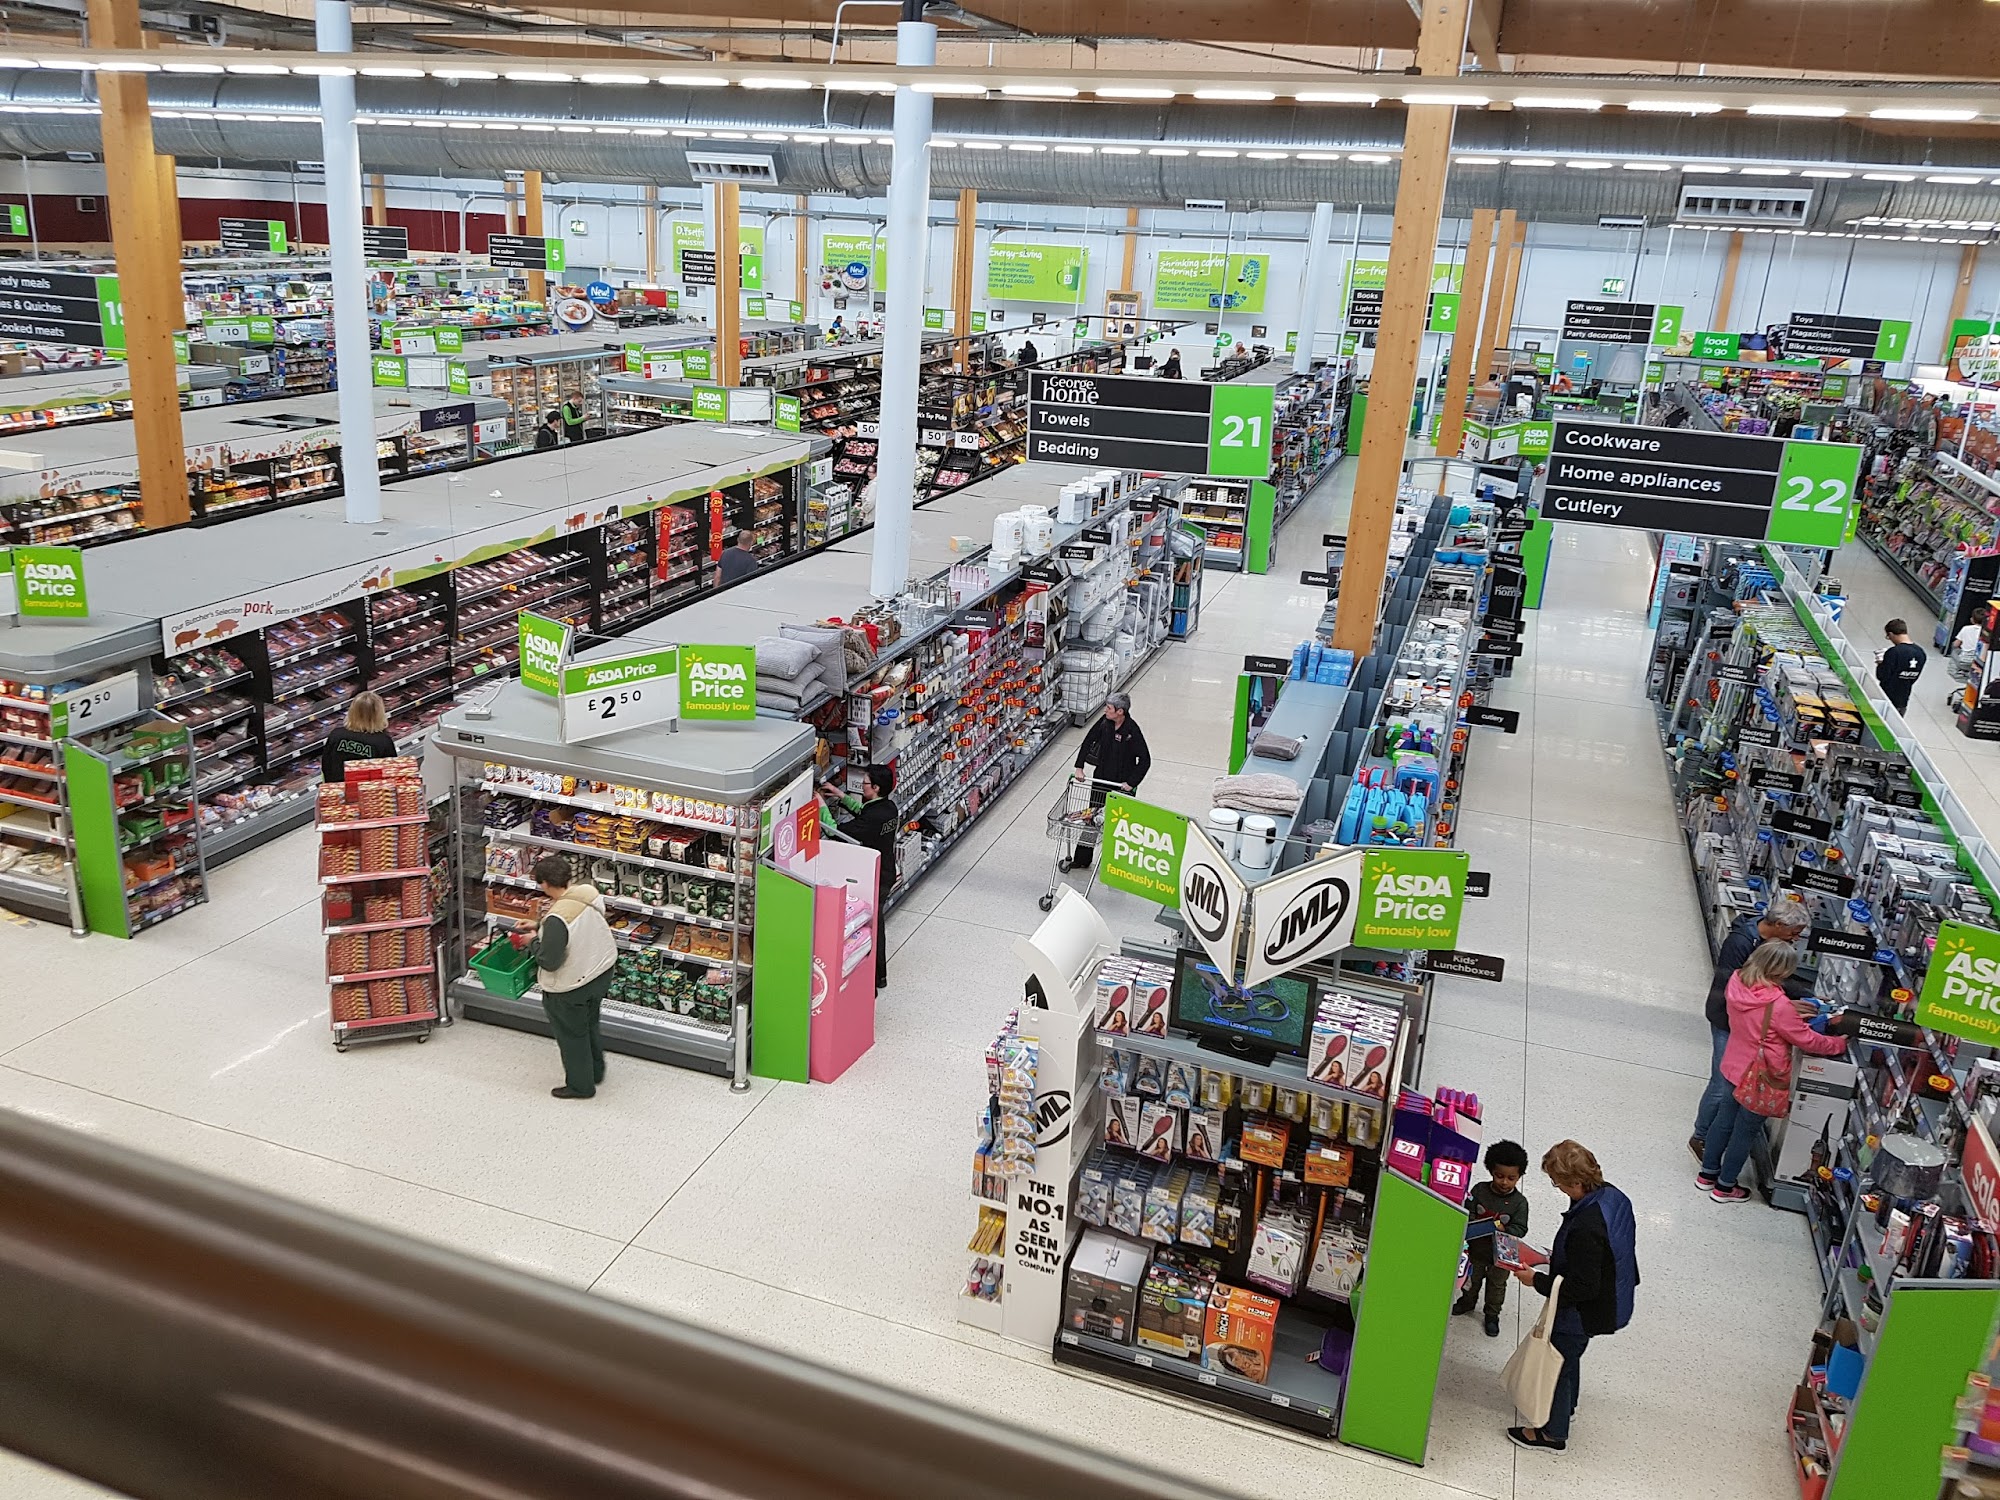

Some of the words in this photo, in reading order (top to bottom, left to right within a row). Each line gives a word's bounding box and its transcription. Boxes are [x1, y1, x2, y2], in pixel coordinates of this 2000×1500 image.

[274, 232, 280, 242] 7
[506, 238, 523, 246] baking
[827, 238, 853, 252] Energy
[552, 250, 560, 261] 5
[1160, 258, 1199, 270] Shrinking
[1201, 256, 1228, 267] carbo
[748, 267, 757, 278] 4
[1159, 267, 1198, 277] footprints
[591, 282, 610, 296] New!
[1355, 305, 1373, 313] Light
[1440, 306, 1452, 320] 3
[1570, 304, 1584, 312] Gift
[1569, 317, 1590, 325] Cards
[1660, 319, 1673, 333] 2
[1795, 315, 1813, 324] Toys
[35, 326, 65, 337] meats
[221, 328, 239, 336] £10
[1566, 330, 1586, 339] Party
[1588, 332, 1631, 340] decorations
[1791, 328, 1832, 339] Magazines
[1704, 337, 1729, 346] food
[1888, 334, 1897, 348] 1
[1714, 348, 1727, 357] go
[1788, 342, 1805, 351] Bike
[1807, 344, 1850, 355] accessories
[378, 360, 401, 369] ASDA
[686, 356, 706, 364] ASDA
[451, 368, 466, 376] ASDA
[658, 363, 667, 372] £2
[452, 376, 465, 384] Price
[697, 392, 721, 402] ASDA
[1042, 380, 1099, 404] home
[698, 401, 720, 411] Price
[779, 403, 797, 413] ASDA
[780, 411, 796, 421] Price
[1039, 410, 1090, 427] Towels
[1220, 416, 1262, 448] 21
[1469, 437, 1479, 449] £40
[1523, 438, 1547, 446] Price
[1565, 431, 1660, 452] Cookware
[1038, 440, 1099, 460] Bedding
[1560, 464, 1614, 482] Home
[1620, 472, 1722, 493] appliances
[1781, 476, 1847, 514] 22
[1554, 497, 1622, 518] Cutlery
[24, 564, 76, 580] ASDA
[1030, 569, 1048, 578] Candles
[1308, 575, 1329, 583] Bedding
[27, 581, 76, 597] Price
[24, 599, 64, 608] famously
[66, 600, 83, 608] low
[171, 623, 183, 633] Our
[185, 612, 214, 628] Butcher's
[215, 606, 242, 618] Selection
[243, 601, 273, 616] pork
[274, 608, 290, 616] joints
[301, 602, 314, 612] hand
[315, 595, 332, 607] scored
[340, 580, 359, 595] perfect
[358, 564, 379, 582] crackling
[965, 614, 987, 622] Candles
[1494, 618, 1516, 626] Kitchen
[525, 633, 558, 657] ASDA
[1488, 643, 1511, 652] Cutlery
[526, 654, 558, 674] Price
[689, 662, 747, 680] ASDA
[587, 668, 623, 686] ASDA
[625, 663, 657, 678] Price
[1722, 672, 1747, 680] Toasters
[692, 681, 744, 698] Price
[686, 702, 730, 712] famously
[732, 702, 750, 711] low
[1481, 713, 1504, 723] cutlery
[1739, 734, 1770, 744] Hardware
[1740, 729, 1771, 738] Electrical
[337, 740, 372, 757] ASDA
[1758, 778, 1793, 789] appliances
[1765, 772, 1788, 781] kitchen
[801, 819, 814, 842] £7
[1793, 821, 1811, 830] irons
[1113, 818, 1175, 856] ASDA
[1114, 840, 1170, 876] Price
[1106, 864, 1153, 887] famously
[1155, 880, 1176, 895] low
[1808, 872, 1838, 884] vacuum
[1374, 875, 1452, 897] ASDA
[1805, 879, 1838, 892] cleaners
[1185, 873, 1222, 922] JML
[1374, 897, 1446, 920] Price
[1268, 886, 1340, 956] JML
[1364, 924, 1425, 938] famously
[1427, 927, 1451, 937] low
[1818, 936, 1865, 951] Hairdryers
[1453, 955, 1478, 966] Kids'
[1433, 961, 1496, 977] Lunchboxes
[1860, 1018, 1898, 1032] Electric
[1928, 1002, 2000, 1035] famously
[1204, 1016, 1229, 1027] AMAZING
[1230, 1021, 1249, 1031] LIQUID
[1249, 1025, 1273, 1037] PLASTIC
[1859, 1027, 1893, 1040] Razors
[1037, 1096, 1071, 1135] ML
[1029, 1180, 1056, 1197] THE
[1972, 1162, 2000, 1231] sale
[1018, 1194, 1064, 1221] NO.1
[1029, 1218, 1051, 1233] AS
[1019, 1230, 1057, 1249] SEEN
[1015, 1243, 1038, 1261] ON
[1043, 1250, 1061, 1266] TV
[1019, 1259, 1055, 1276] COMPANY
[1219, 1314, 1229, 1340] ARCH
